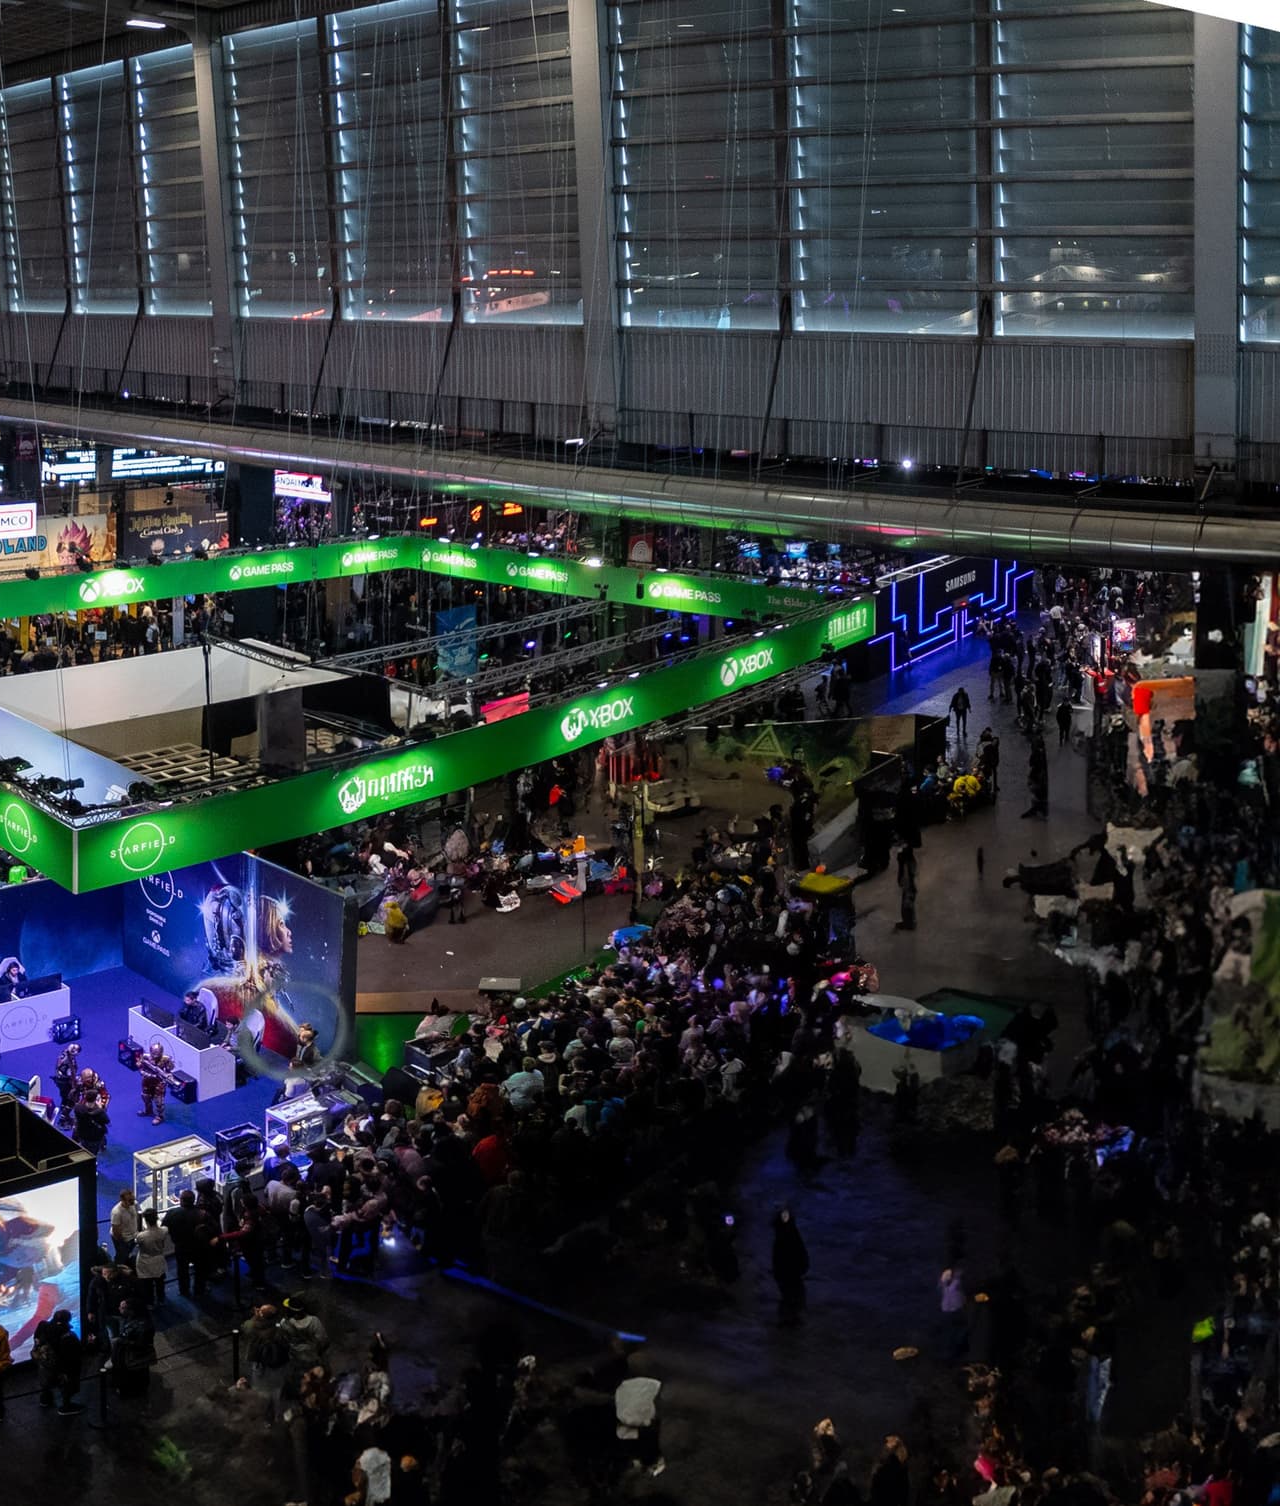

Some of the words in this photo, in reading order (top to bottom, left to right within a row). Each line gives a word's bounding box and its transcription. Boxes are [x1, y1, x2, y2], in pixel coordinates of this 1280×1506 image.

[378, 549, 398, 560] PASS
[243, 564, 270, 577] GAME
[271, 561, 294, 573] PASS
[945, 570, 976, 592] SAMSUNG
[695, 590, 721, 604] PASS
[739, 648, 774, 677] XBOX
[589, 696, 634, 729] XBOX
[109, 835, 176, 859] STARFIELD
